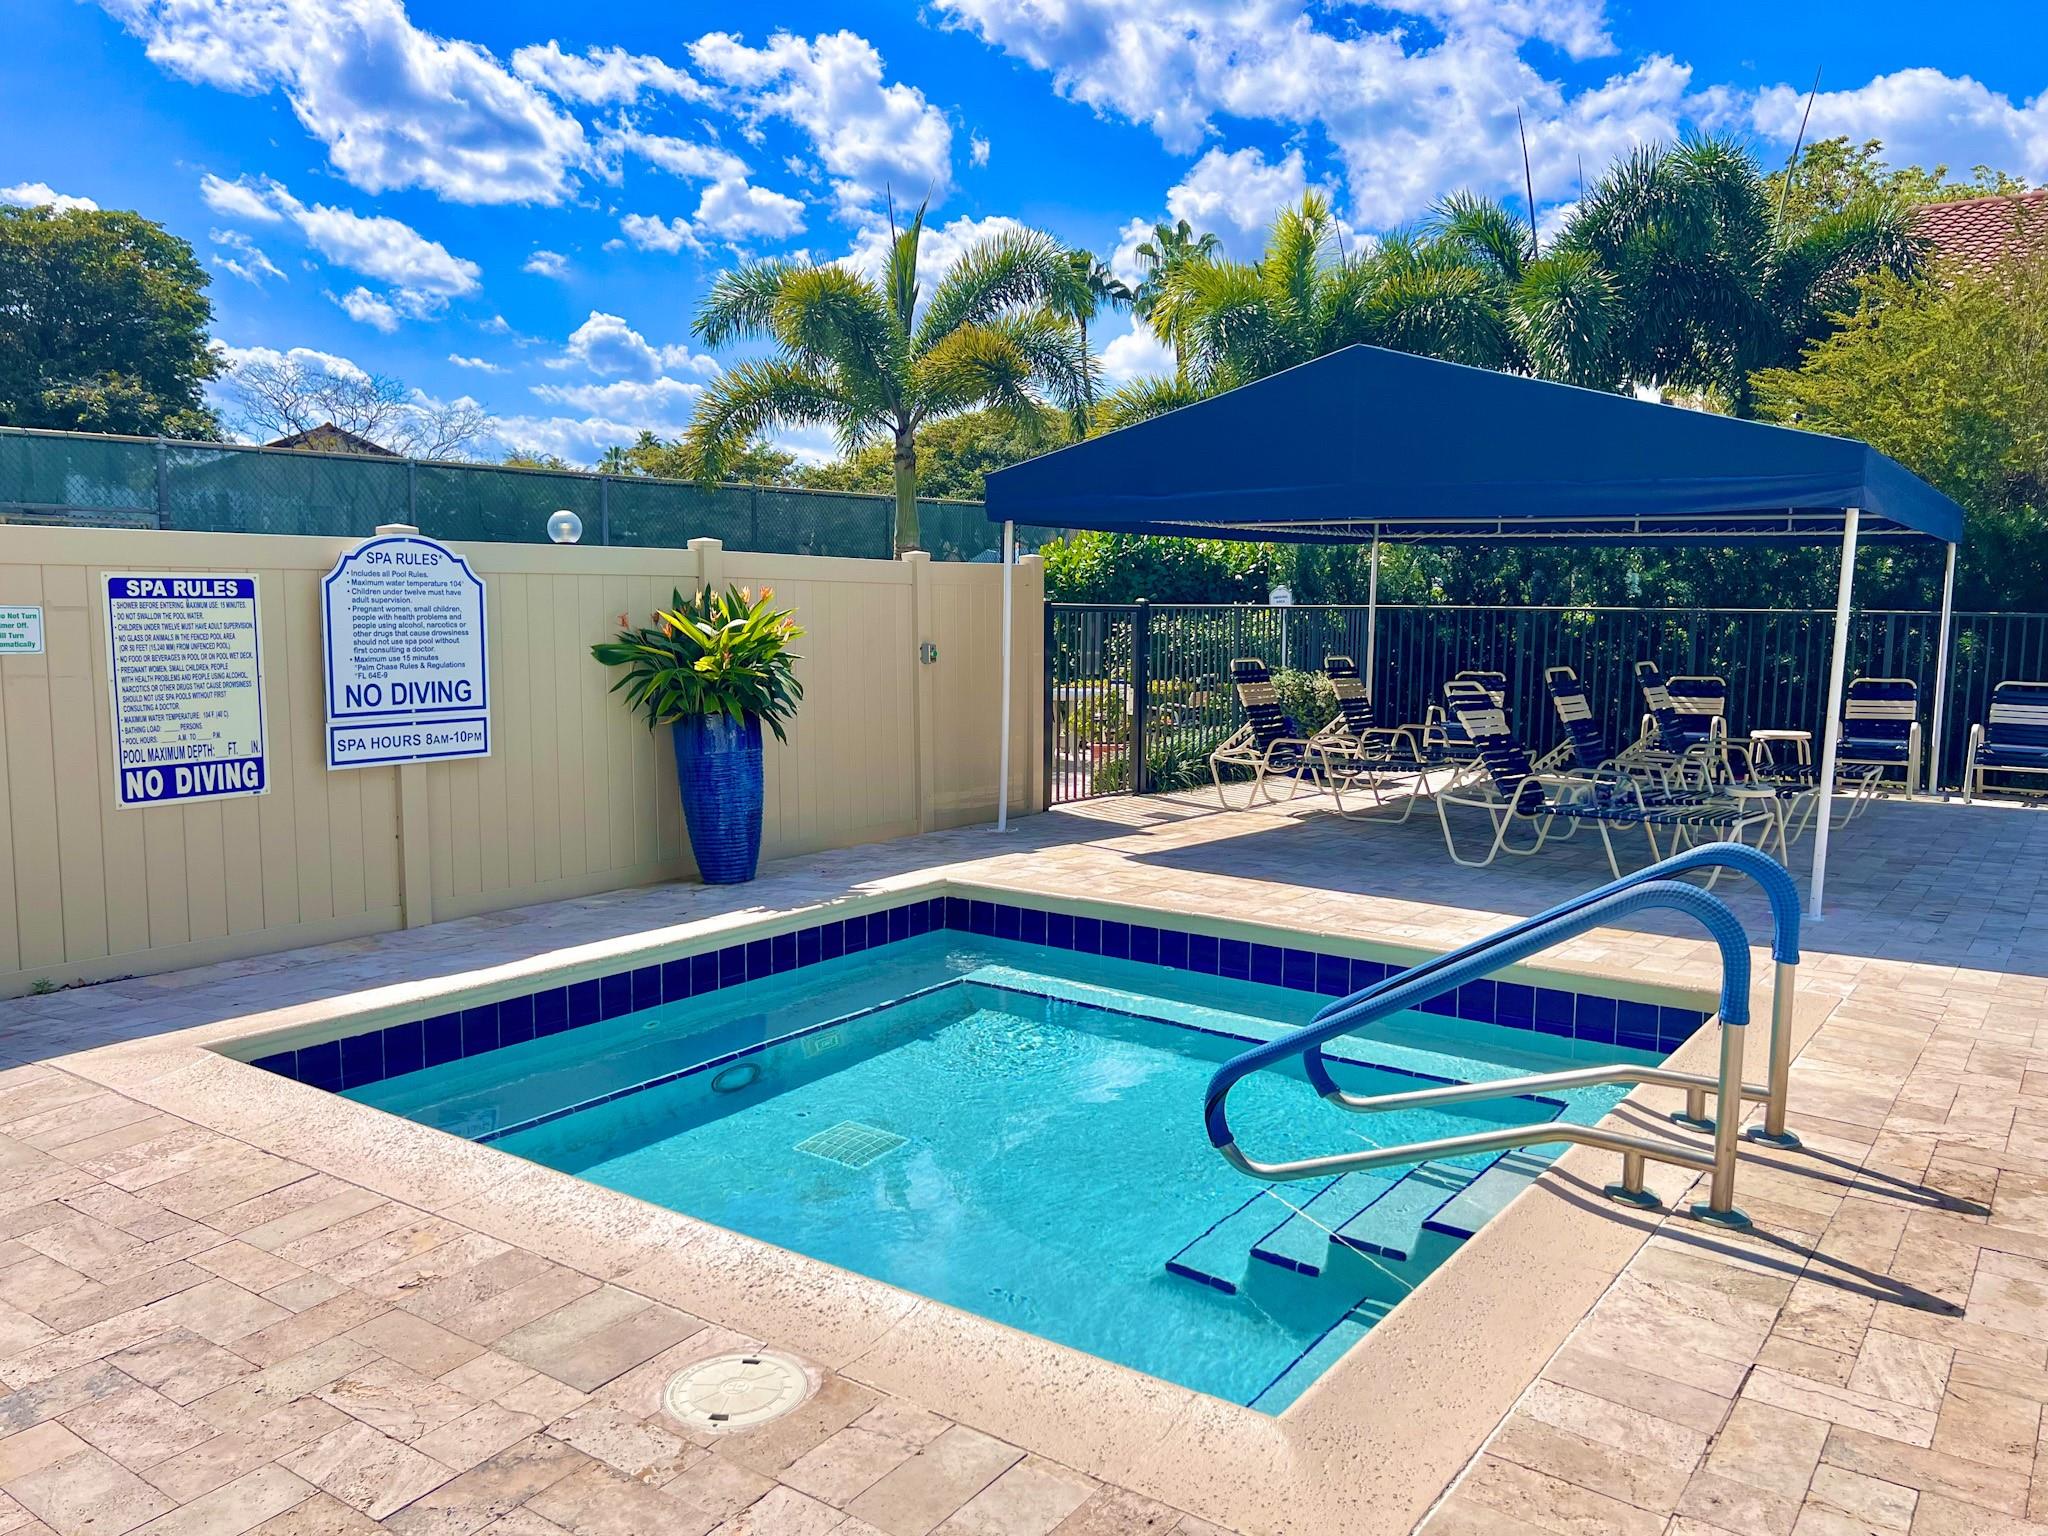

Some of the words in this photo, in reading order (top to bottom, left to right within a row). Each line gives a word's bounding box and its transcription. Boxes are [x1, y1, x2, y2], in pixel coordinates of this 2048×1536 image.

[366, 552, 392, 564] SPA
[126, 580, 168, 596] SPA
[174, 580, 238, 596] RULES
[353, 614, 376, 622] people
[122, 684, 150, 692] NARCOTICS
[346, 684, 382, 708] NO
[392, 680, 472, 705] DIVING
[125, 726, 146, 734] BATHING
[338, 738, 366, 752] SPA
[372, 735, 420, 749] HOURS
[426, 731, 482, 745] 8AM-10PM
[124, 748, 146, 764] POOL
[148, 745, 186, 762] MAXIMUM
[188, 744, 215, 759] DEPTH:
[228, 742, 238, 756] FT.
[251, 740, 260, 754] IN.
[126, 768, 164, 799] NO
[176, 761, 258, 794] DIVING
